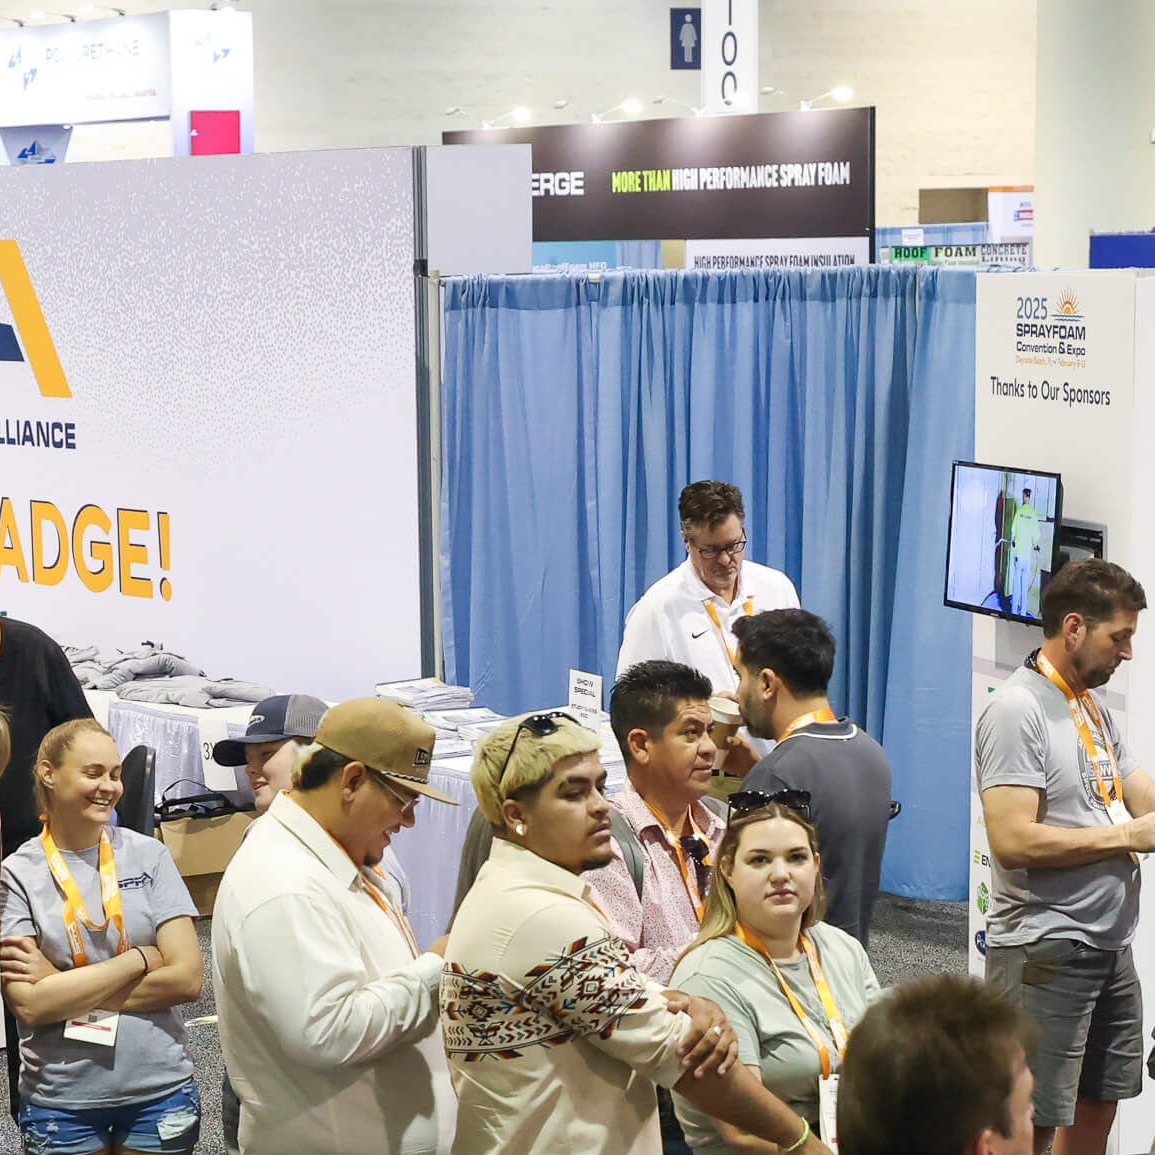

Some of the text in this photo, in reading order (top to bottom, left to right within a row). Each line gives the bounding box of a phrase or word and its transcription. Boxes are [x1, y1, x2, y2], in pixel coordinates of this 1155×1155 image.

[612, 161, 850, 193] MORE THAN HIGH PERFORMANCE SPRAY FOAM
[894, 243, 1027, 259] ROOF FOAM CONCRETE
[694, 254, 855, 268] HIGH PERFORMANCE SPRAY FOAM INSULATION
[1016, 296, 1048, 320] 2025
[1016, 323, 1086, 340] SPRAYFOAM
[1016, 341, 1086, 357] Convention & Expo
[990, 376, 1111, 408] Thanks to Our Sponsors
